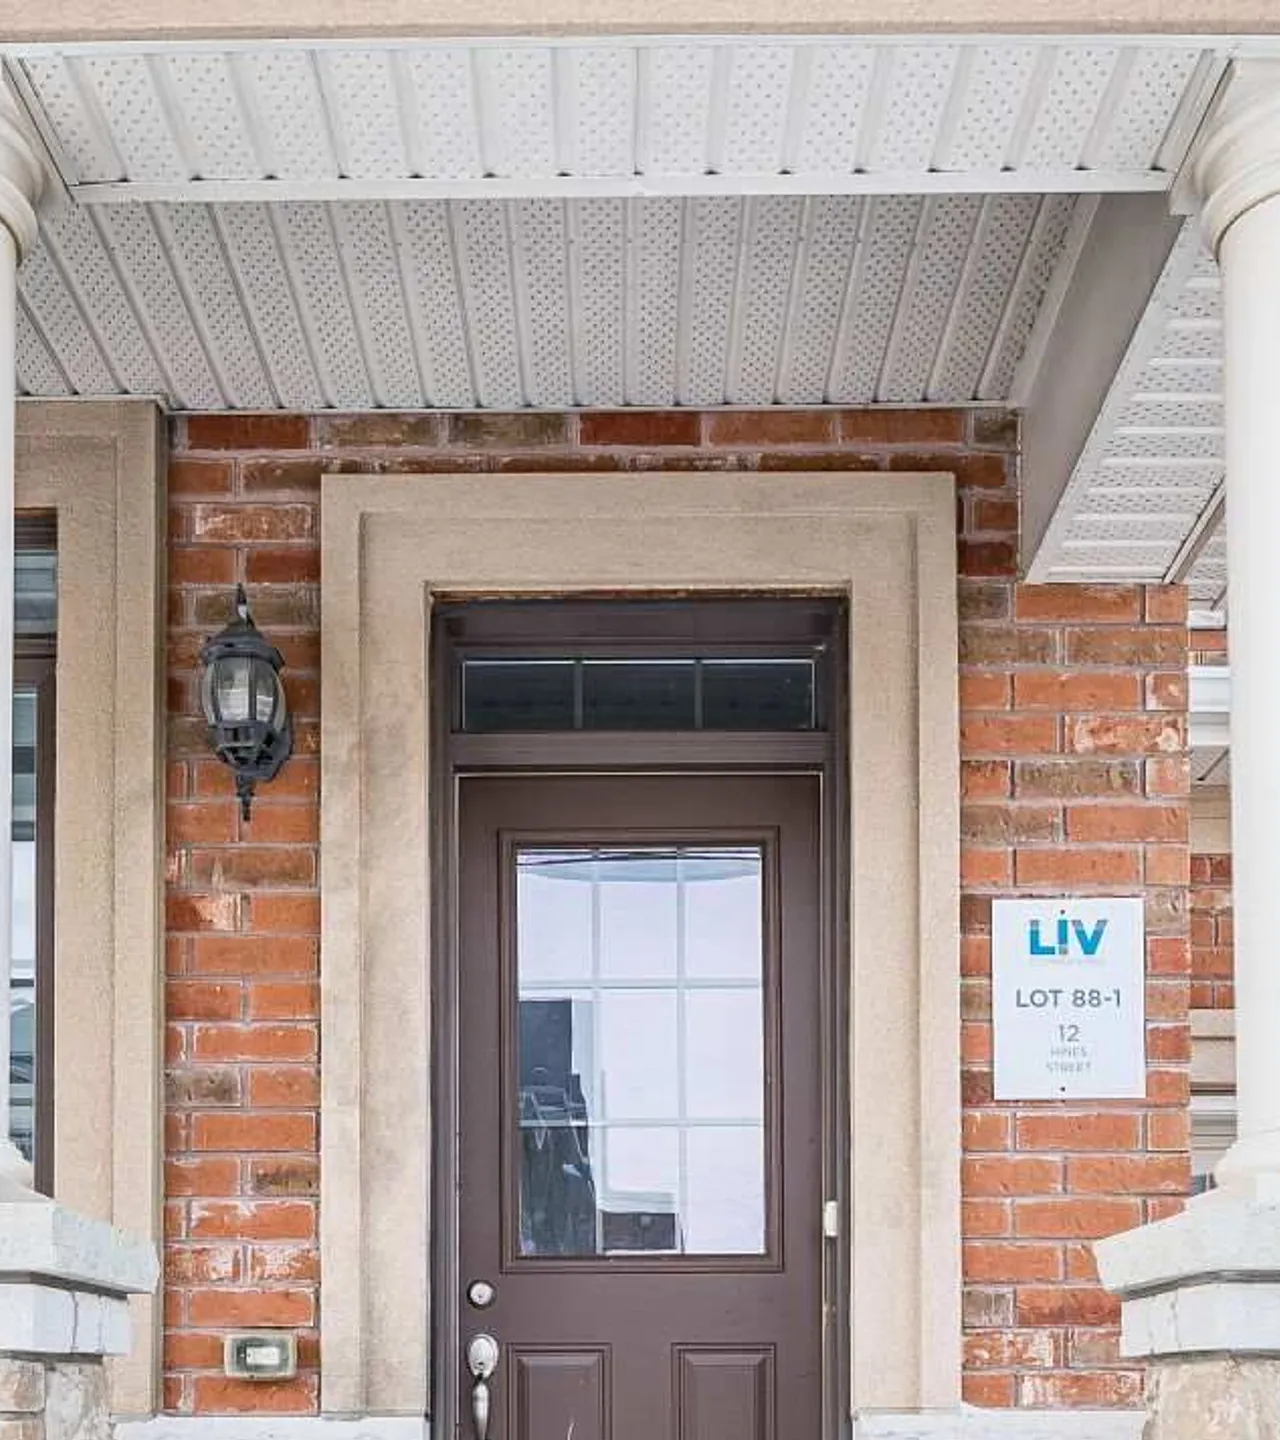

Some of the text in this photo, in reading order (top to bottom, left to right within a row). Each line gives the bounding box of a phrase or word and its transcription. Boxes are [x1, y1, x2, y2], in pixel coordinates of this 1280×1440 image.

[1029, 919, 1109, 956] LIV
[1016, 989, 1121, 1008] LOT 88-1
[1059, 1024, 1080, 1043] 12
